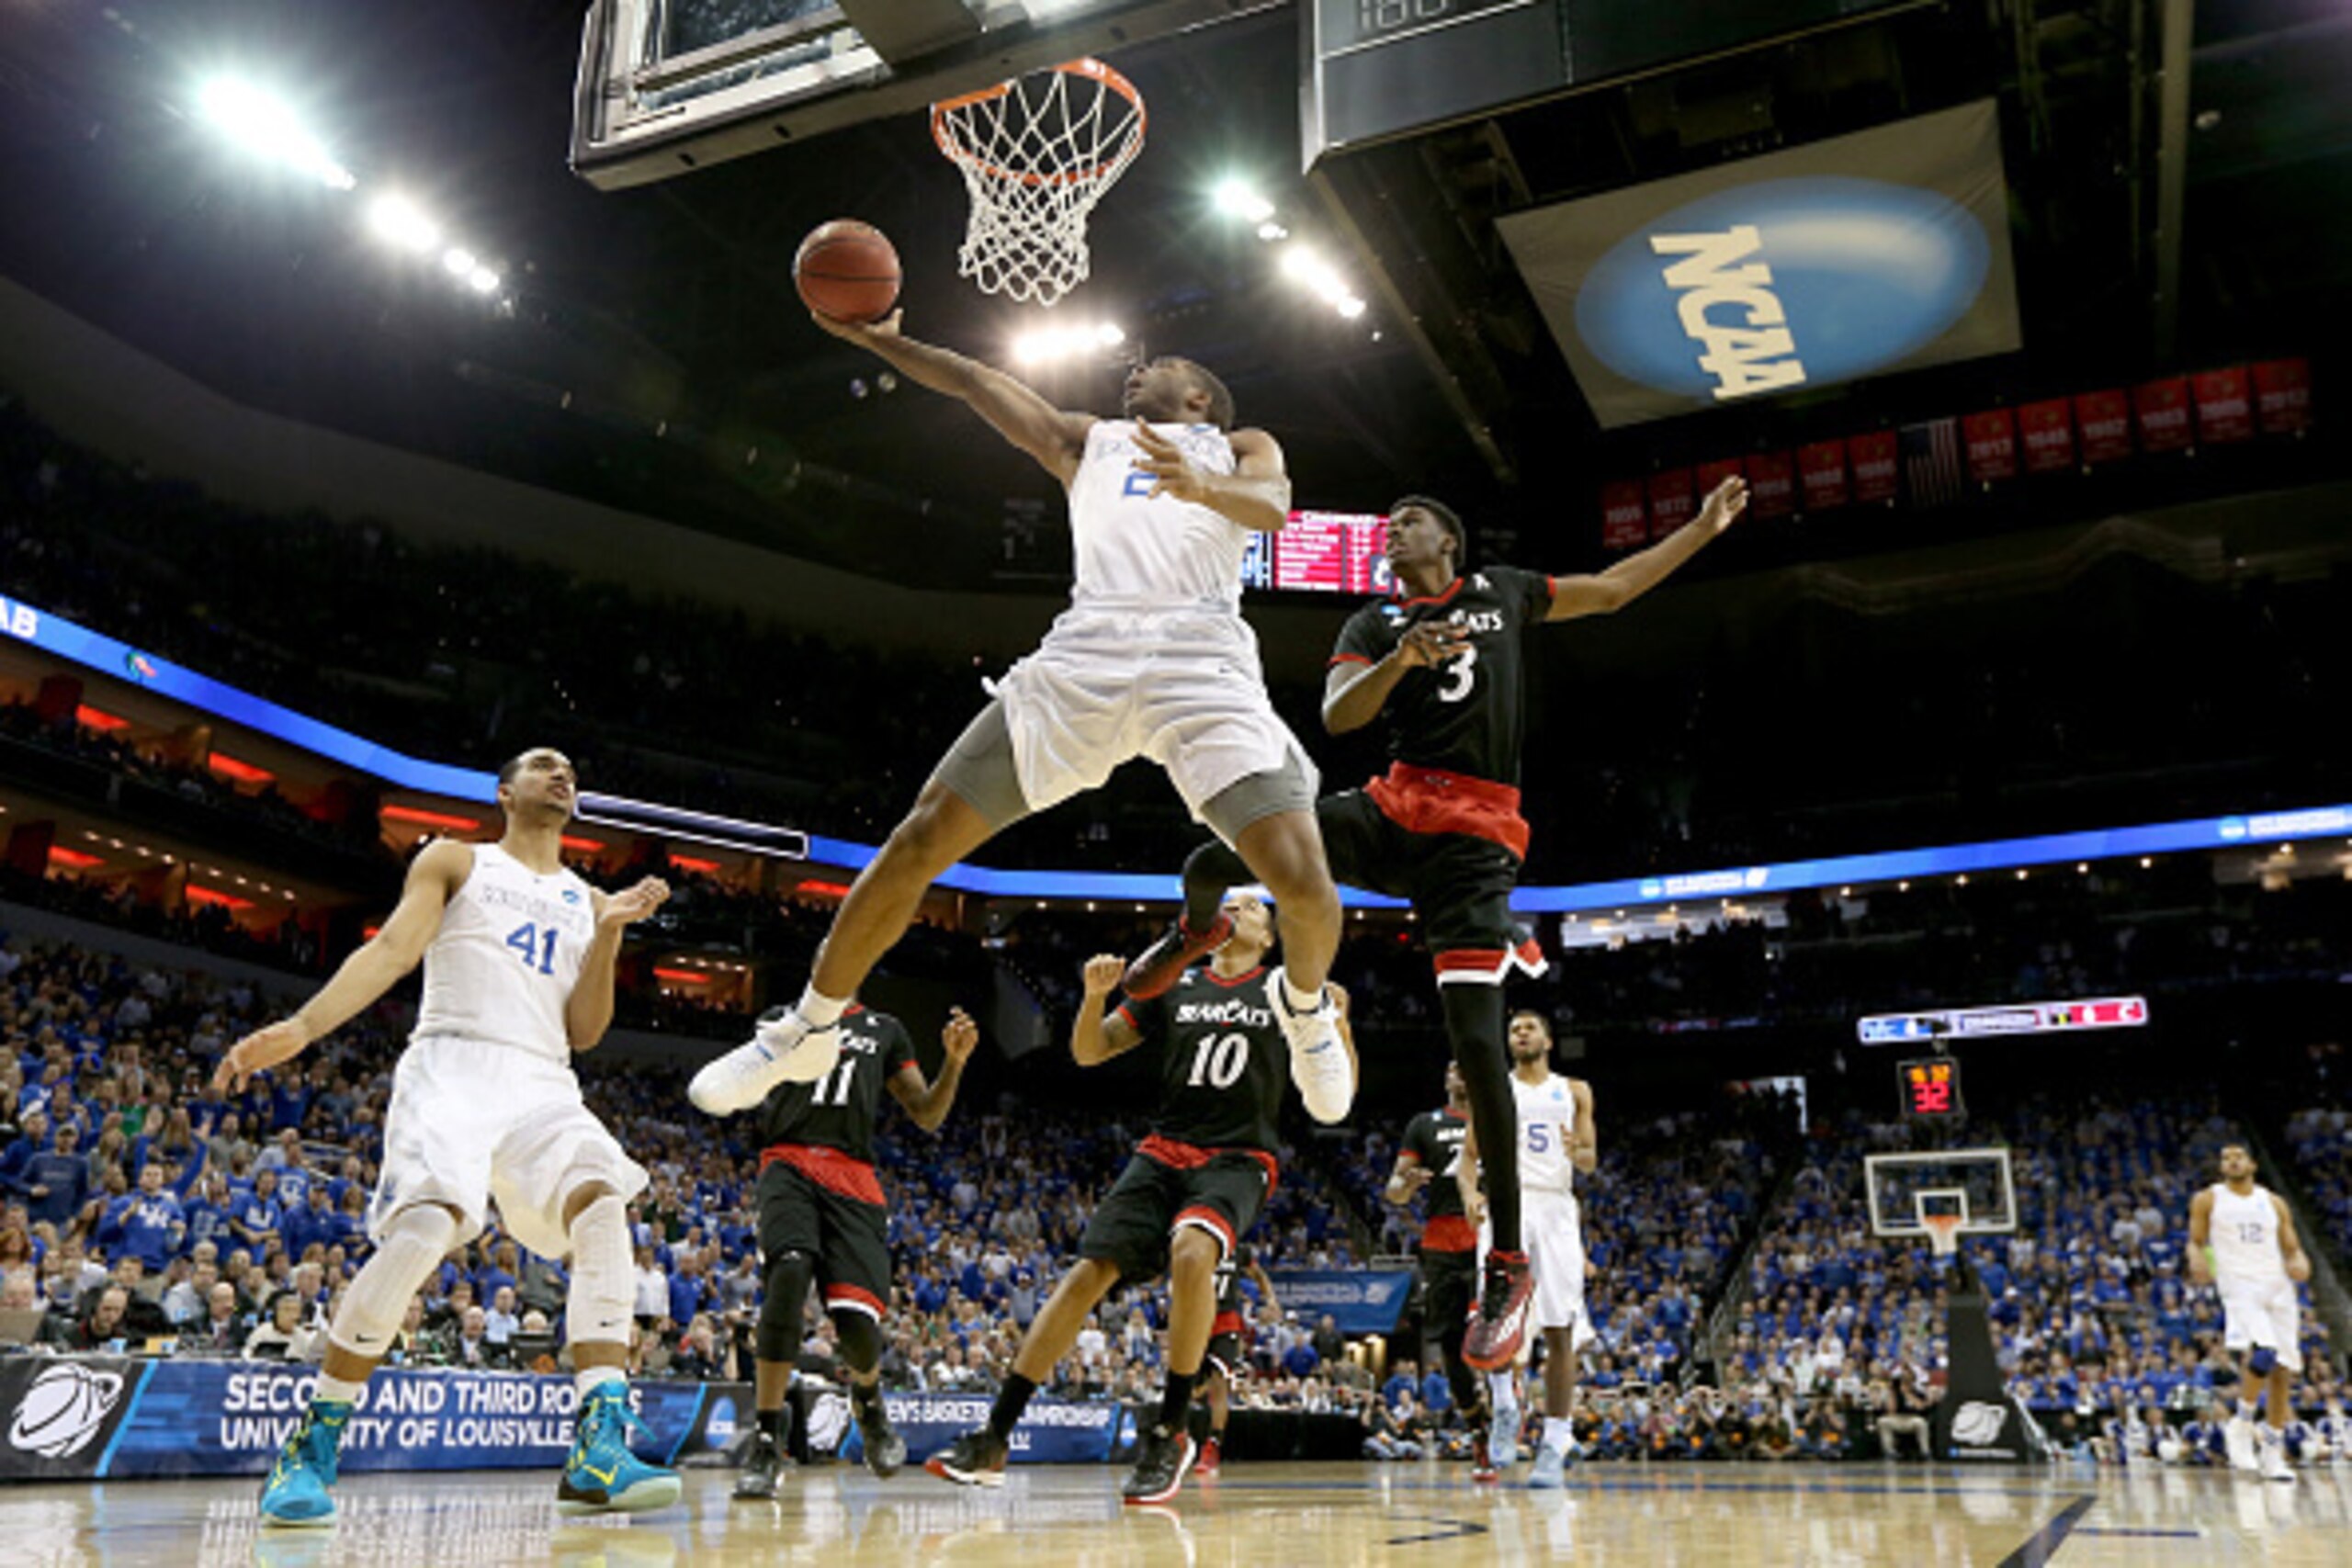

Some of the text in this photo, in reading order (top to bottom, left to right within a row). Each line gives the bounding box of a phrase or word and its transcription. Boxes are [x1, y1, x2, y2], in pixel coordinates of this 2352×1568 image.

[1650, 225, 1806, 400] NCAA
[1438, 642, 1477, 703] 3
[506, 921, 559, 976] 41
[810, 1056, 856, 1106] 11
[1187, 1032, 1250, 1089] 10
[1911, 1082, 1950, 1113] 32
[1528, 1123, 1550, 1153] 5
[2237, 1222, 2264, 1244] 12
[223, 1374, 642, 1415] SECOD AND THIRD ROS
[397, 1417, 437, 1448] OF
